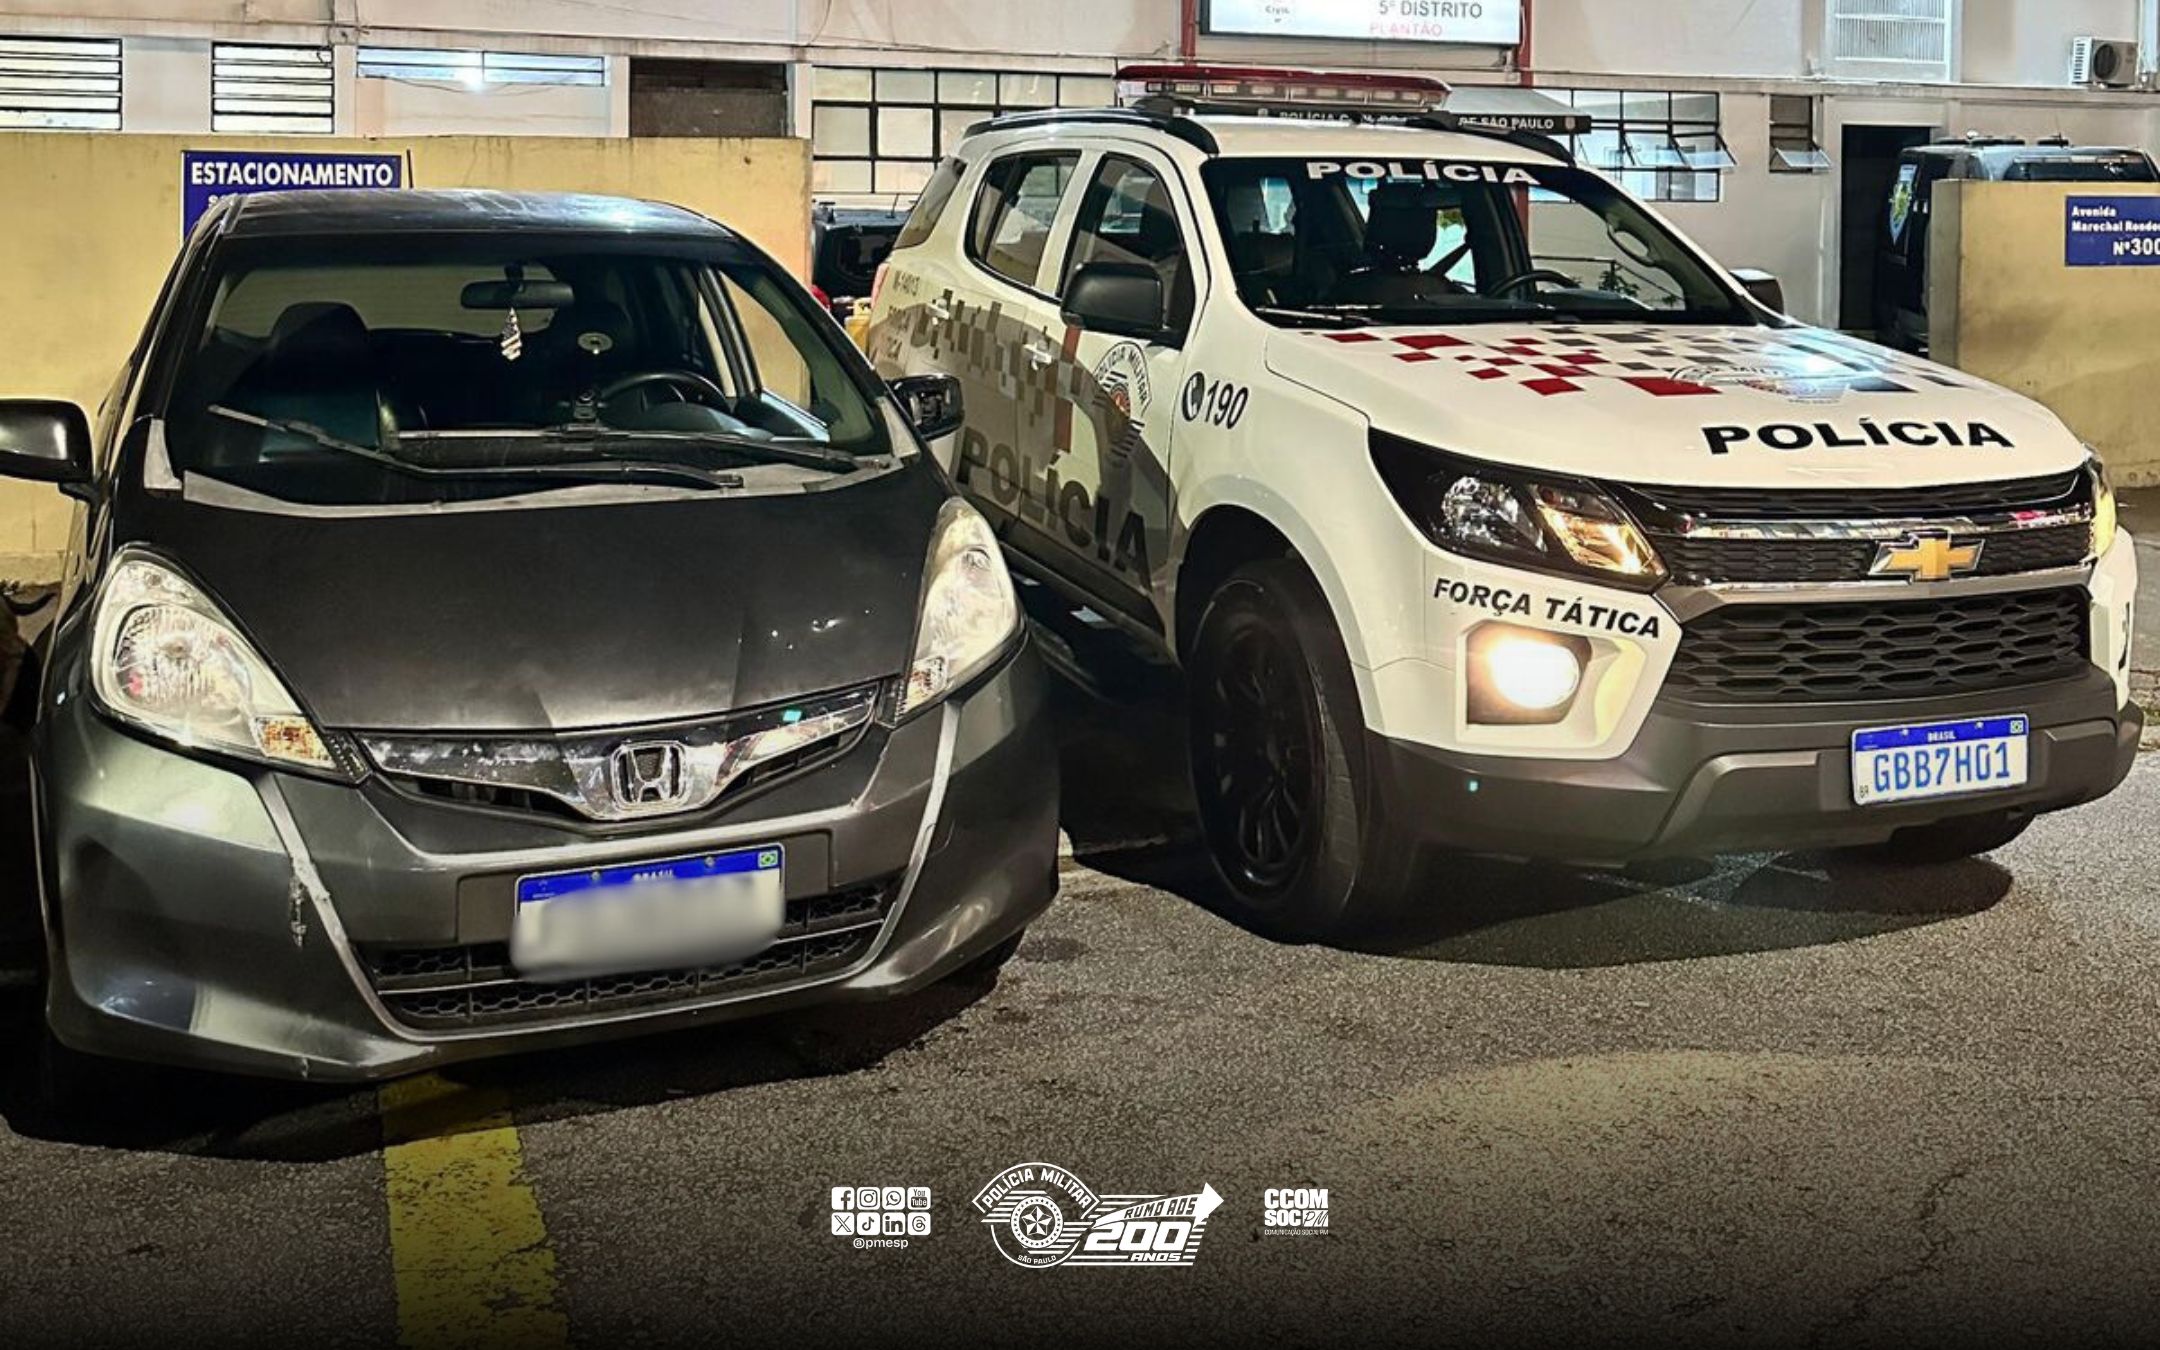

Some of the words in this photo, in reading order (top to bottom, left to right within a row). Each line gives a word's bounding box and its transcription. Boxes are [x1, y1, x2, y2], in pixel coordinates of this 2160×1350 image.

[1400, 1, 1483, 19] DISTRITO
[1369, 22, 1443, 37] PLANTÃO
[1511, 117, 1555, 130] PAULO
[191, 161, 394, 187] ESTACIONAMENTO
[1306, 160, 1541, 185] POLÍCIA
[2072, 205, 2117, 217] Avenida
[2071, 219, 2123, 232] Marechal
[2125, 219, 2160, 232] Rondo
[1204, 378, 1249, 430] 190
[1701, 416, 2016, 455] POLÍCIA
[1434, 578, 1532, 616] FORÇA
[1545, 596, 1660, 638] TÁTICA
[1927, 730, 1957, 743] BRASIL
[1873, 742, 2012, 794] GBB7H01
